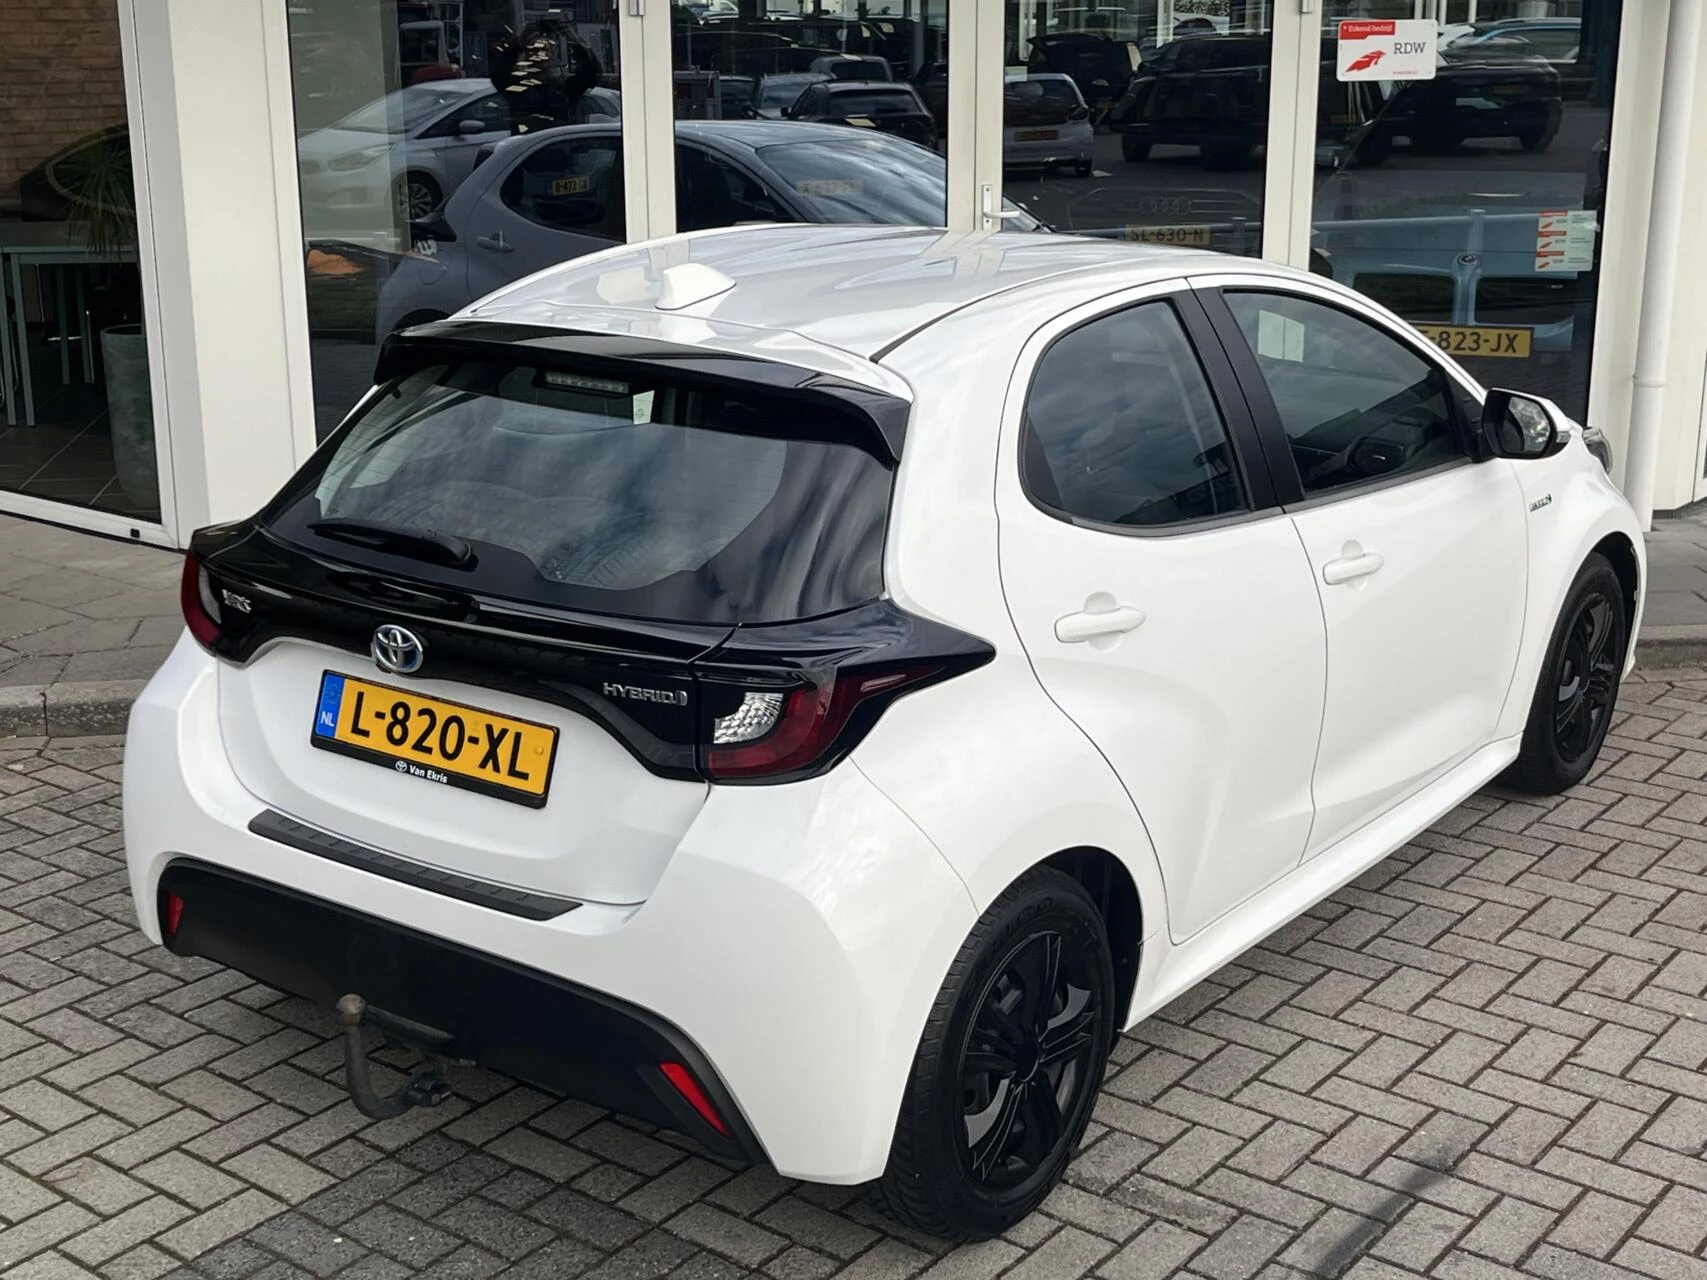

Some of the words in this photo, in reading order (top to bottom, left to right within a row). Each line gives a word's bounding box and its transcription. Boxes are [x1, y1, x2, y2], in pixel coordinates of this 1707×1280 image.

[1393, 42, 1426, 54] RDW
[1420, 330, 1519, 353] -823-JX
[603, 682, 677, 704] HYBRID
[320, 711, 335, 727] NL
[351, 691, 529, 781] L-820-XL
[409, 764, 425, 778] Van
[427, 770, 448, 784] Ekris
